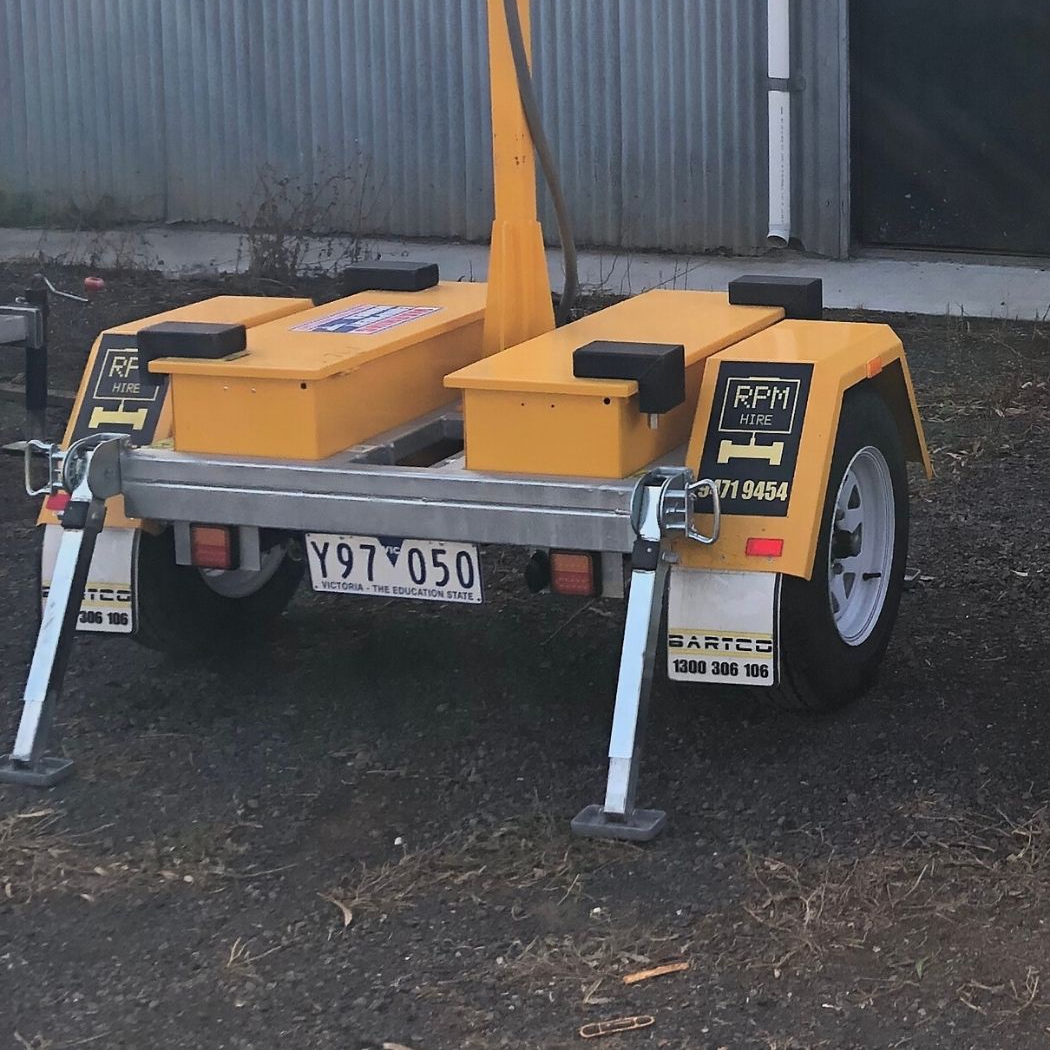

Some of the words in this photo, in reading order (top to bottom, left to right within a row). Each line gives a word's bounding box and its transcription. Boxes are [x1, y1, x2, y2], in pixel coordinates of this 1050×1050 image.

[108, 356, 139, 378] RP
[112, 382, 140, 393] HIRE
[733, 385, 790, 410] RPM
[740, 413, 773, 426] HIRE
[741, 479, 789, 501] 9454
[384, 545, 400, 554] VIC
[310, 541, 376, 582] Y97
[407, 547, 474, 589] 050
[321, 581, 364, 592] VICTORIA
[373, 584, 390, 595] THE
[392, 586, 445, 599] EDUCATION
[446, 590, 474, 601] STATE
[79, 610, 103, 624] 306
[107, 612, 129, 626] 106
[668, 634, 773, 653] BARTCO
[673, 659, 707, 674] 1300
[711, 661, 739, 676] 306
[744, 663, 769, 678] 106
